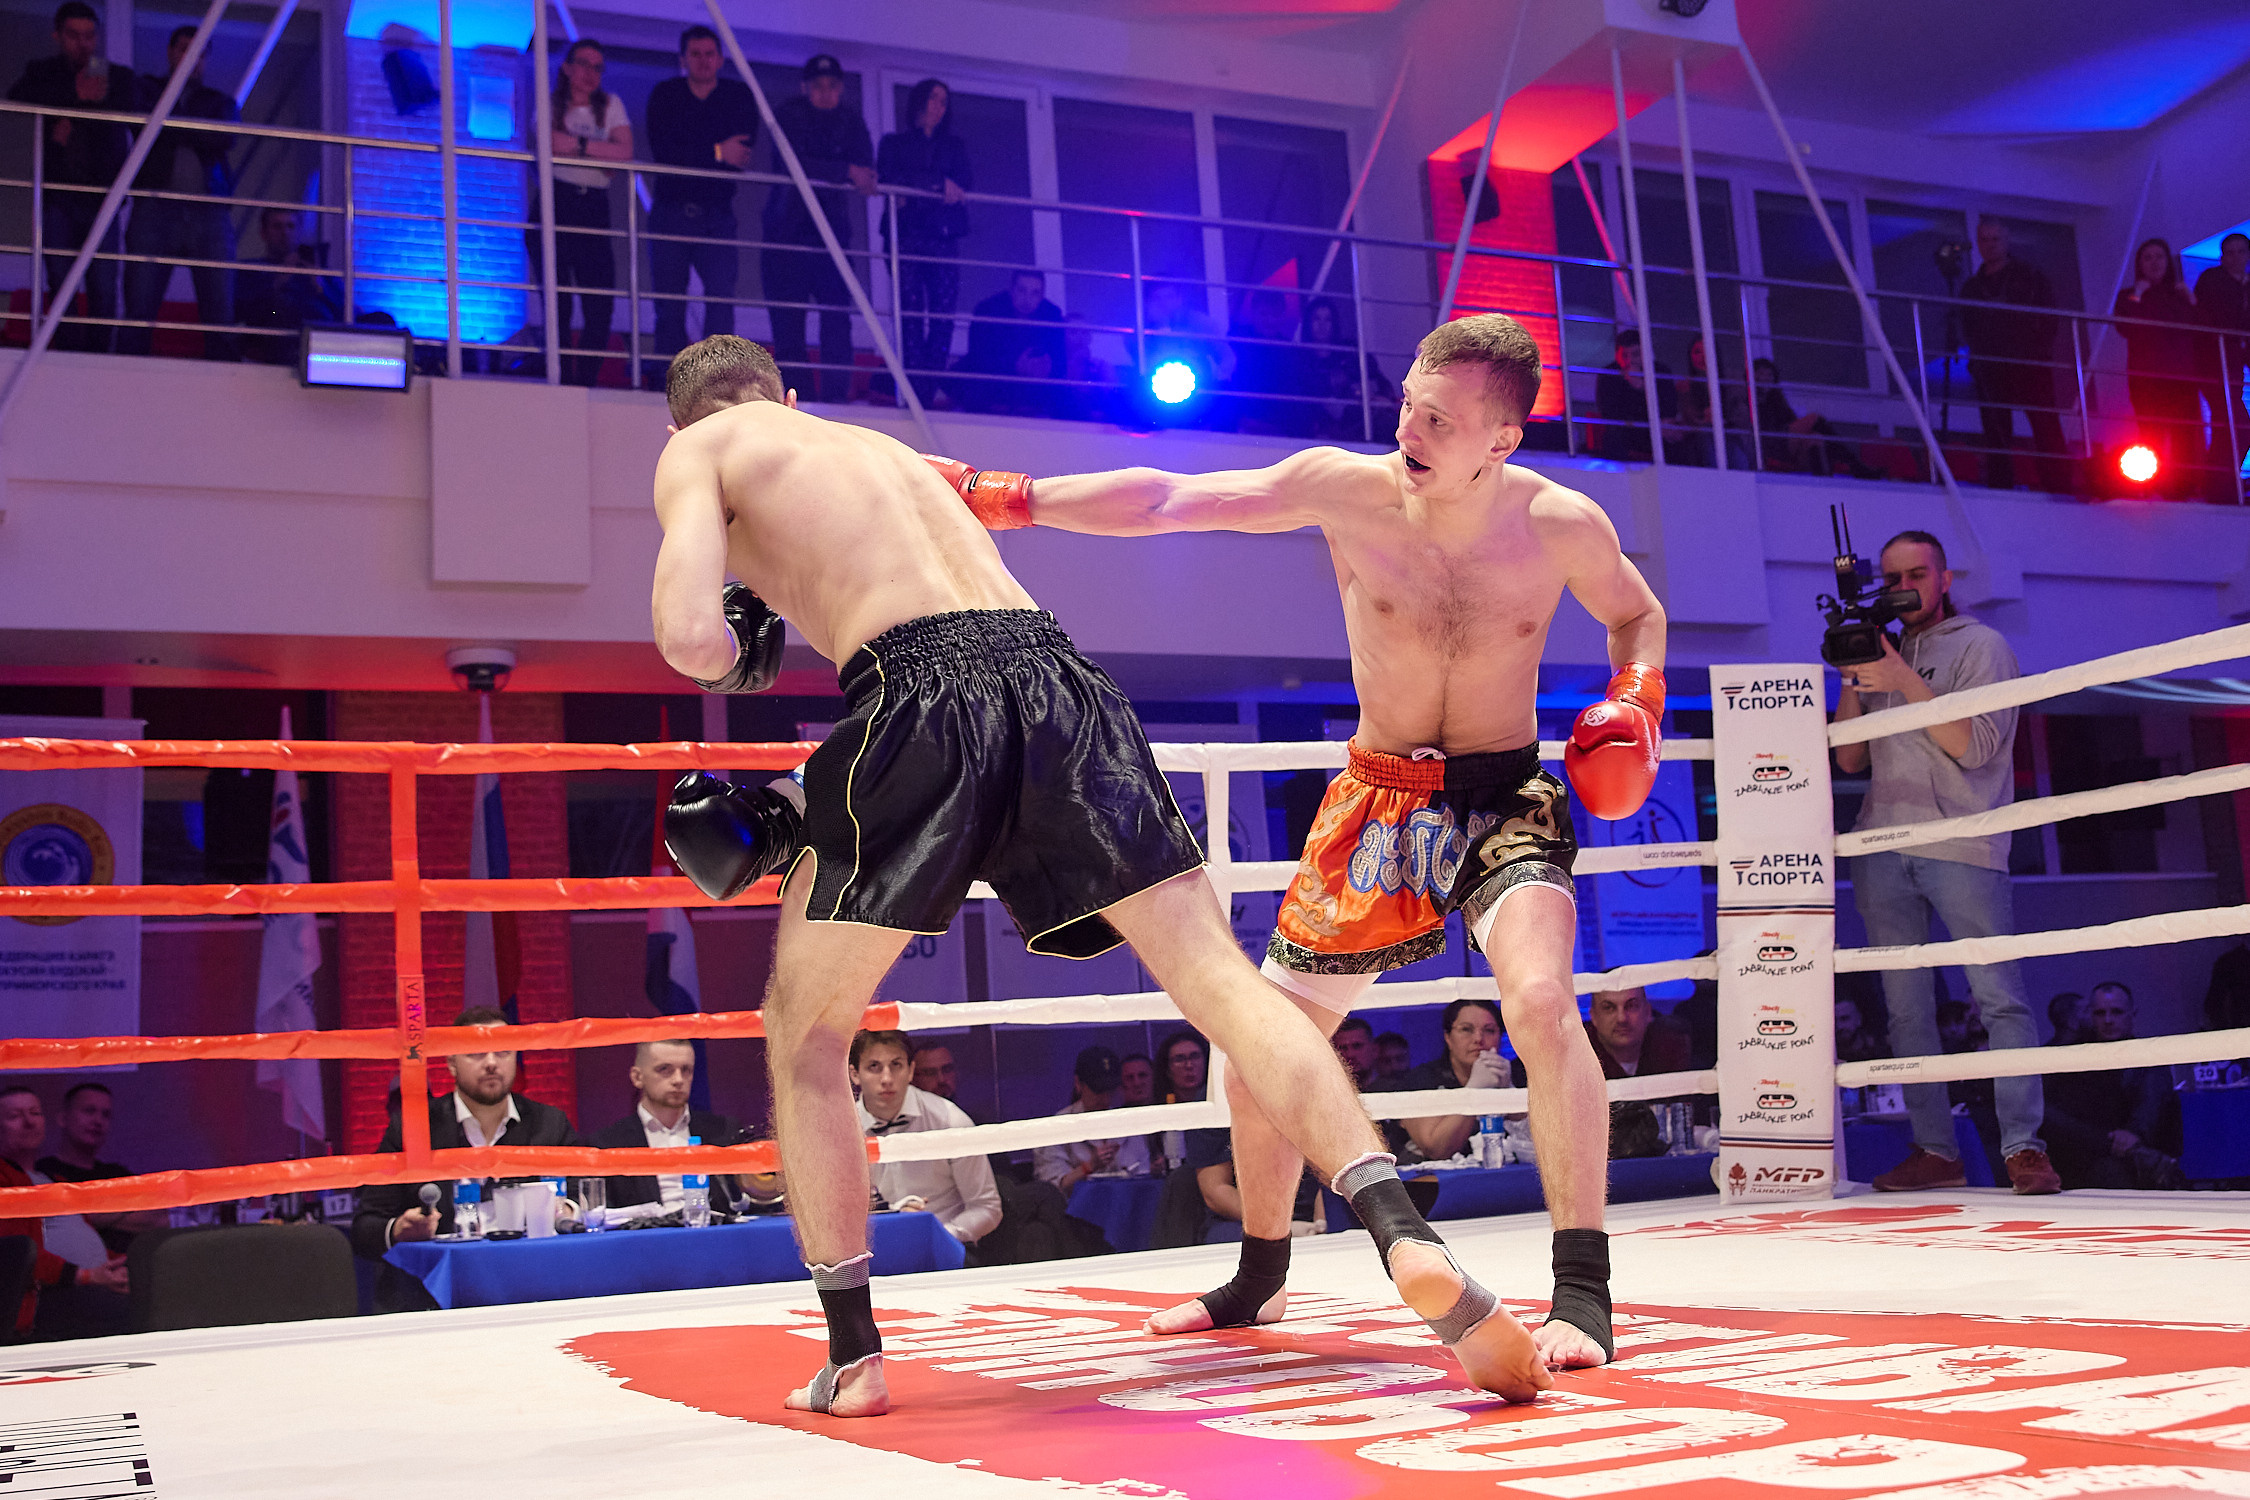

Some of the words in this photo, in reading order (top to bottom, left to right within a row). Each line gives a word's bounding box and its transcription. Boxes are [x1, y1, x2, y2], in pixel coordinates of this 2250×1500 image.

[1750, 678, 1813, 693] АРЕНА
[1738, 695, 1814, 710] СПОРТА
[1759, 853, 1823, 867] АРЕНА
[1747, 871, 1824, 886] СПОРТА
[407, 982, 421, 1041] SPARTA
[1754, 1166, 1825, 1183] MFP
[1248, 1292, 2250, 1450] ЕСТИВА
